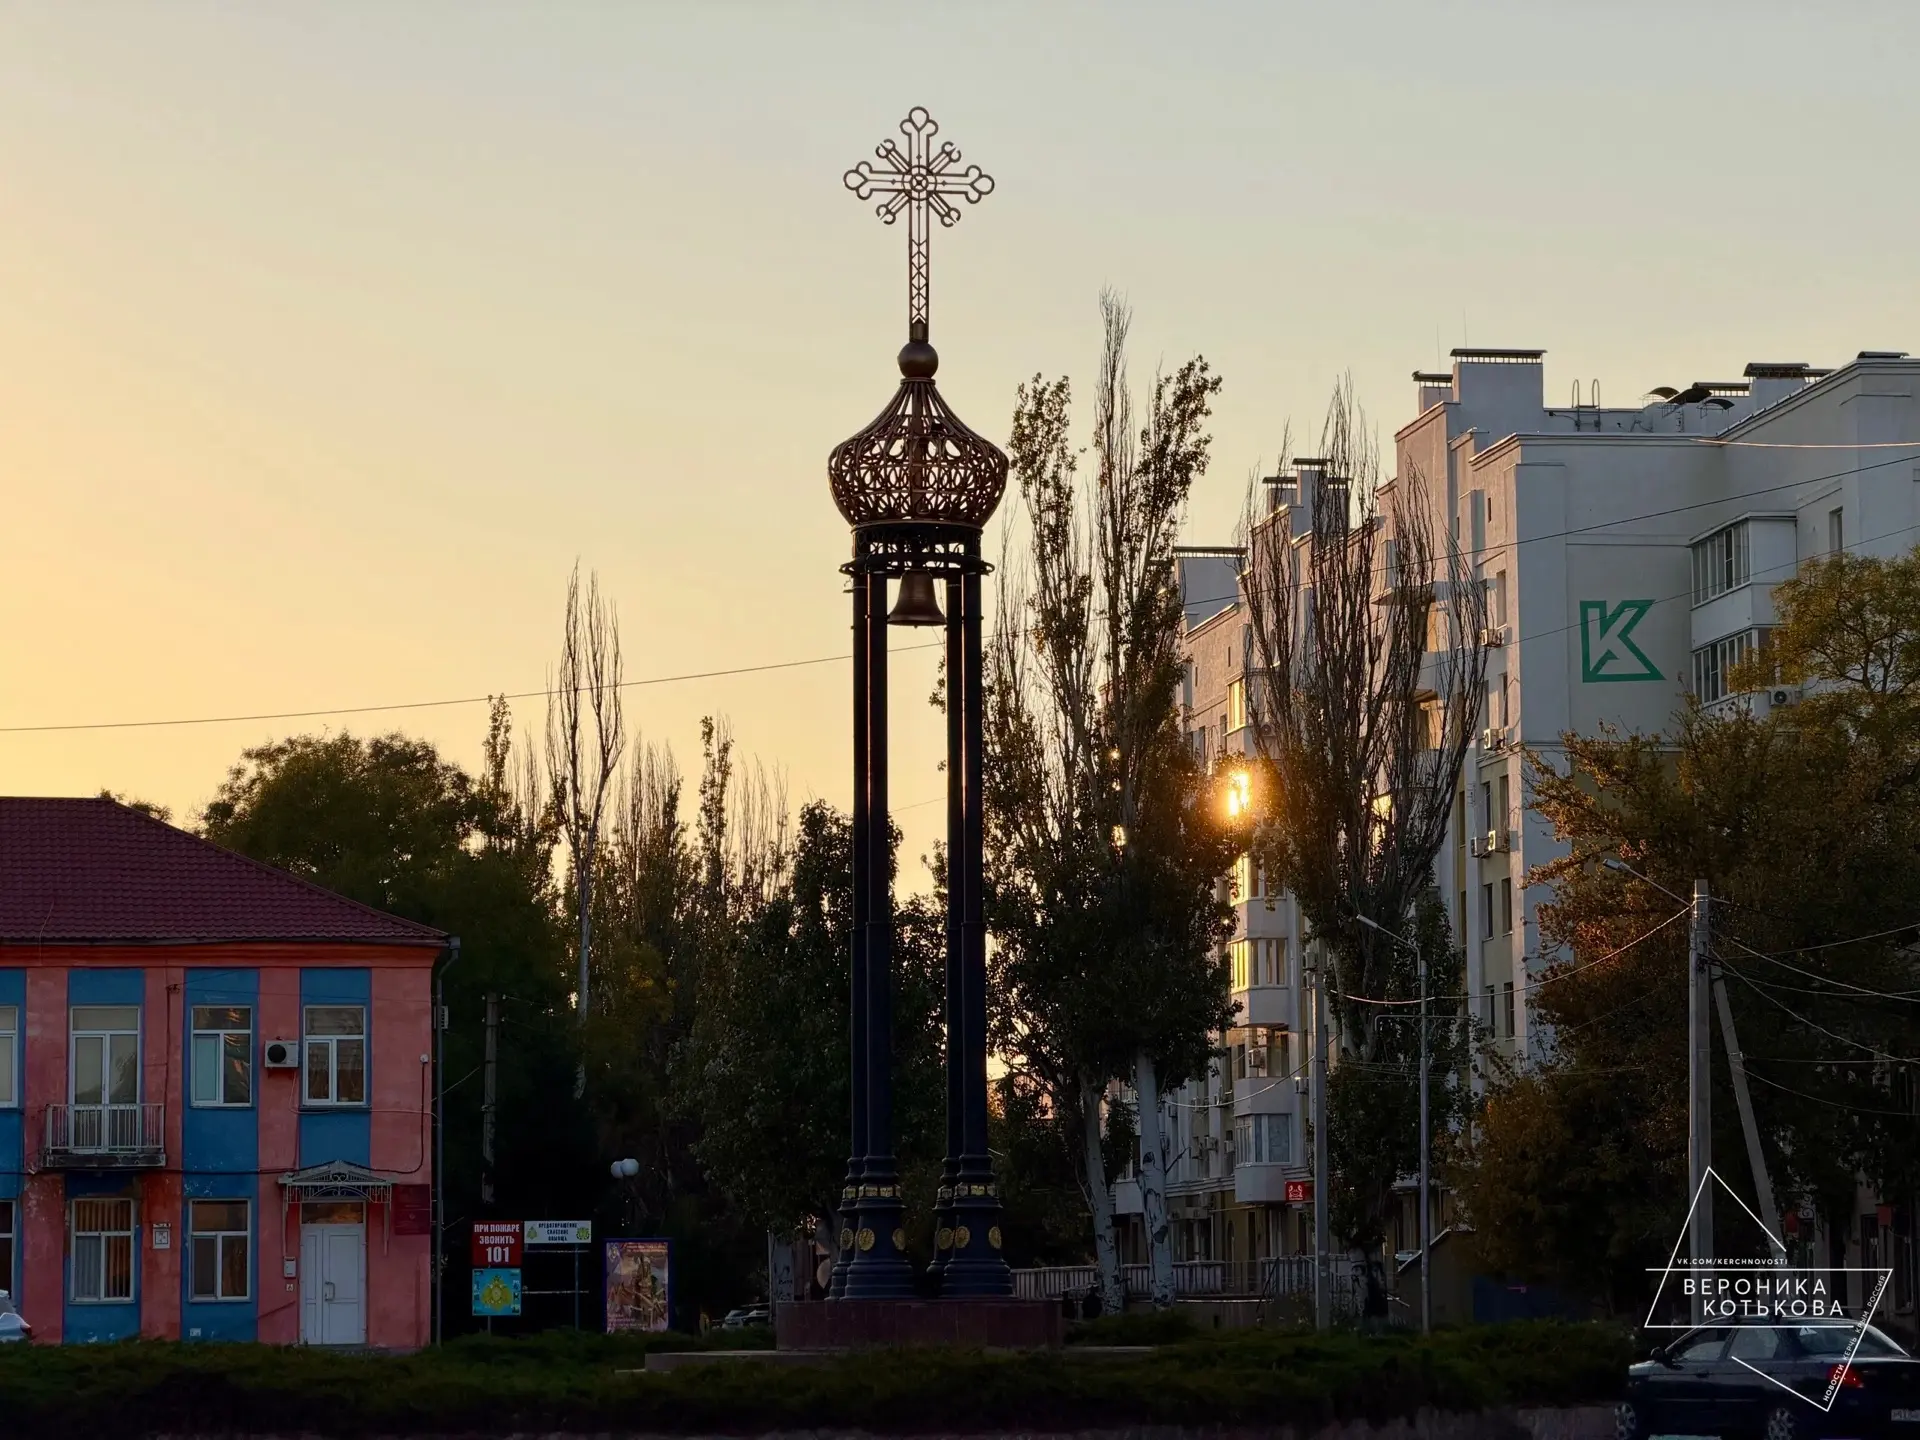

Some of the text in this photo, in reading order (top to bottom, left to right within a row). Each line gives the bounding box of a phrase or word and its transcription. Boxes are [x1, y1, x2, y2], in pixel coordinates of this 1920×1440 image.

[474, 1224, 520, 1233] ПРИ ПОЖАРЕ
[479, 1235, 515, 1245] ЗВОНИТЬ
[485, 1246, 510, 1263] 101
